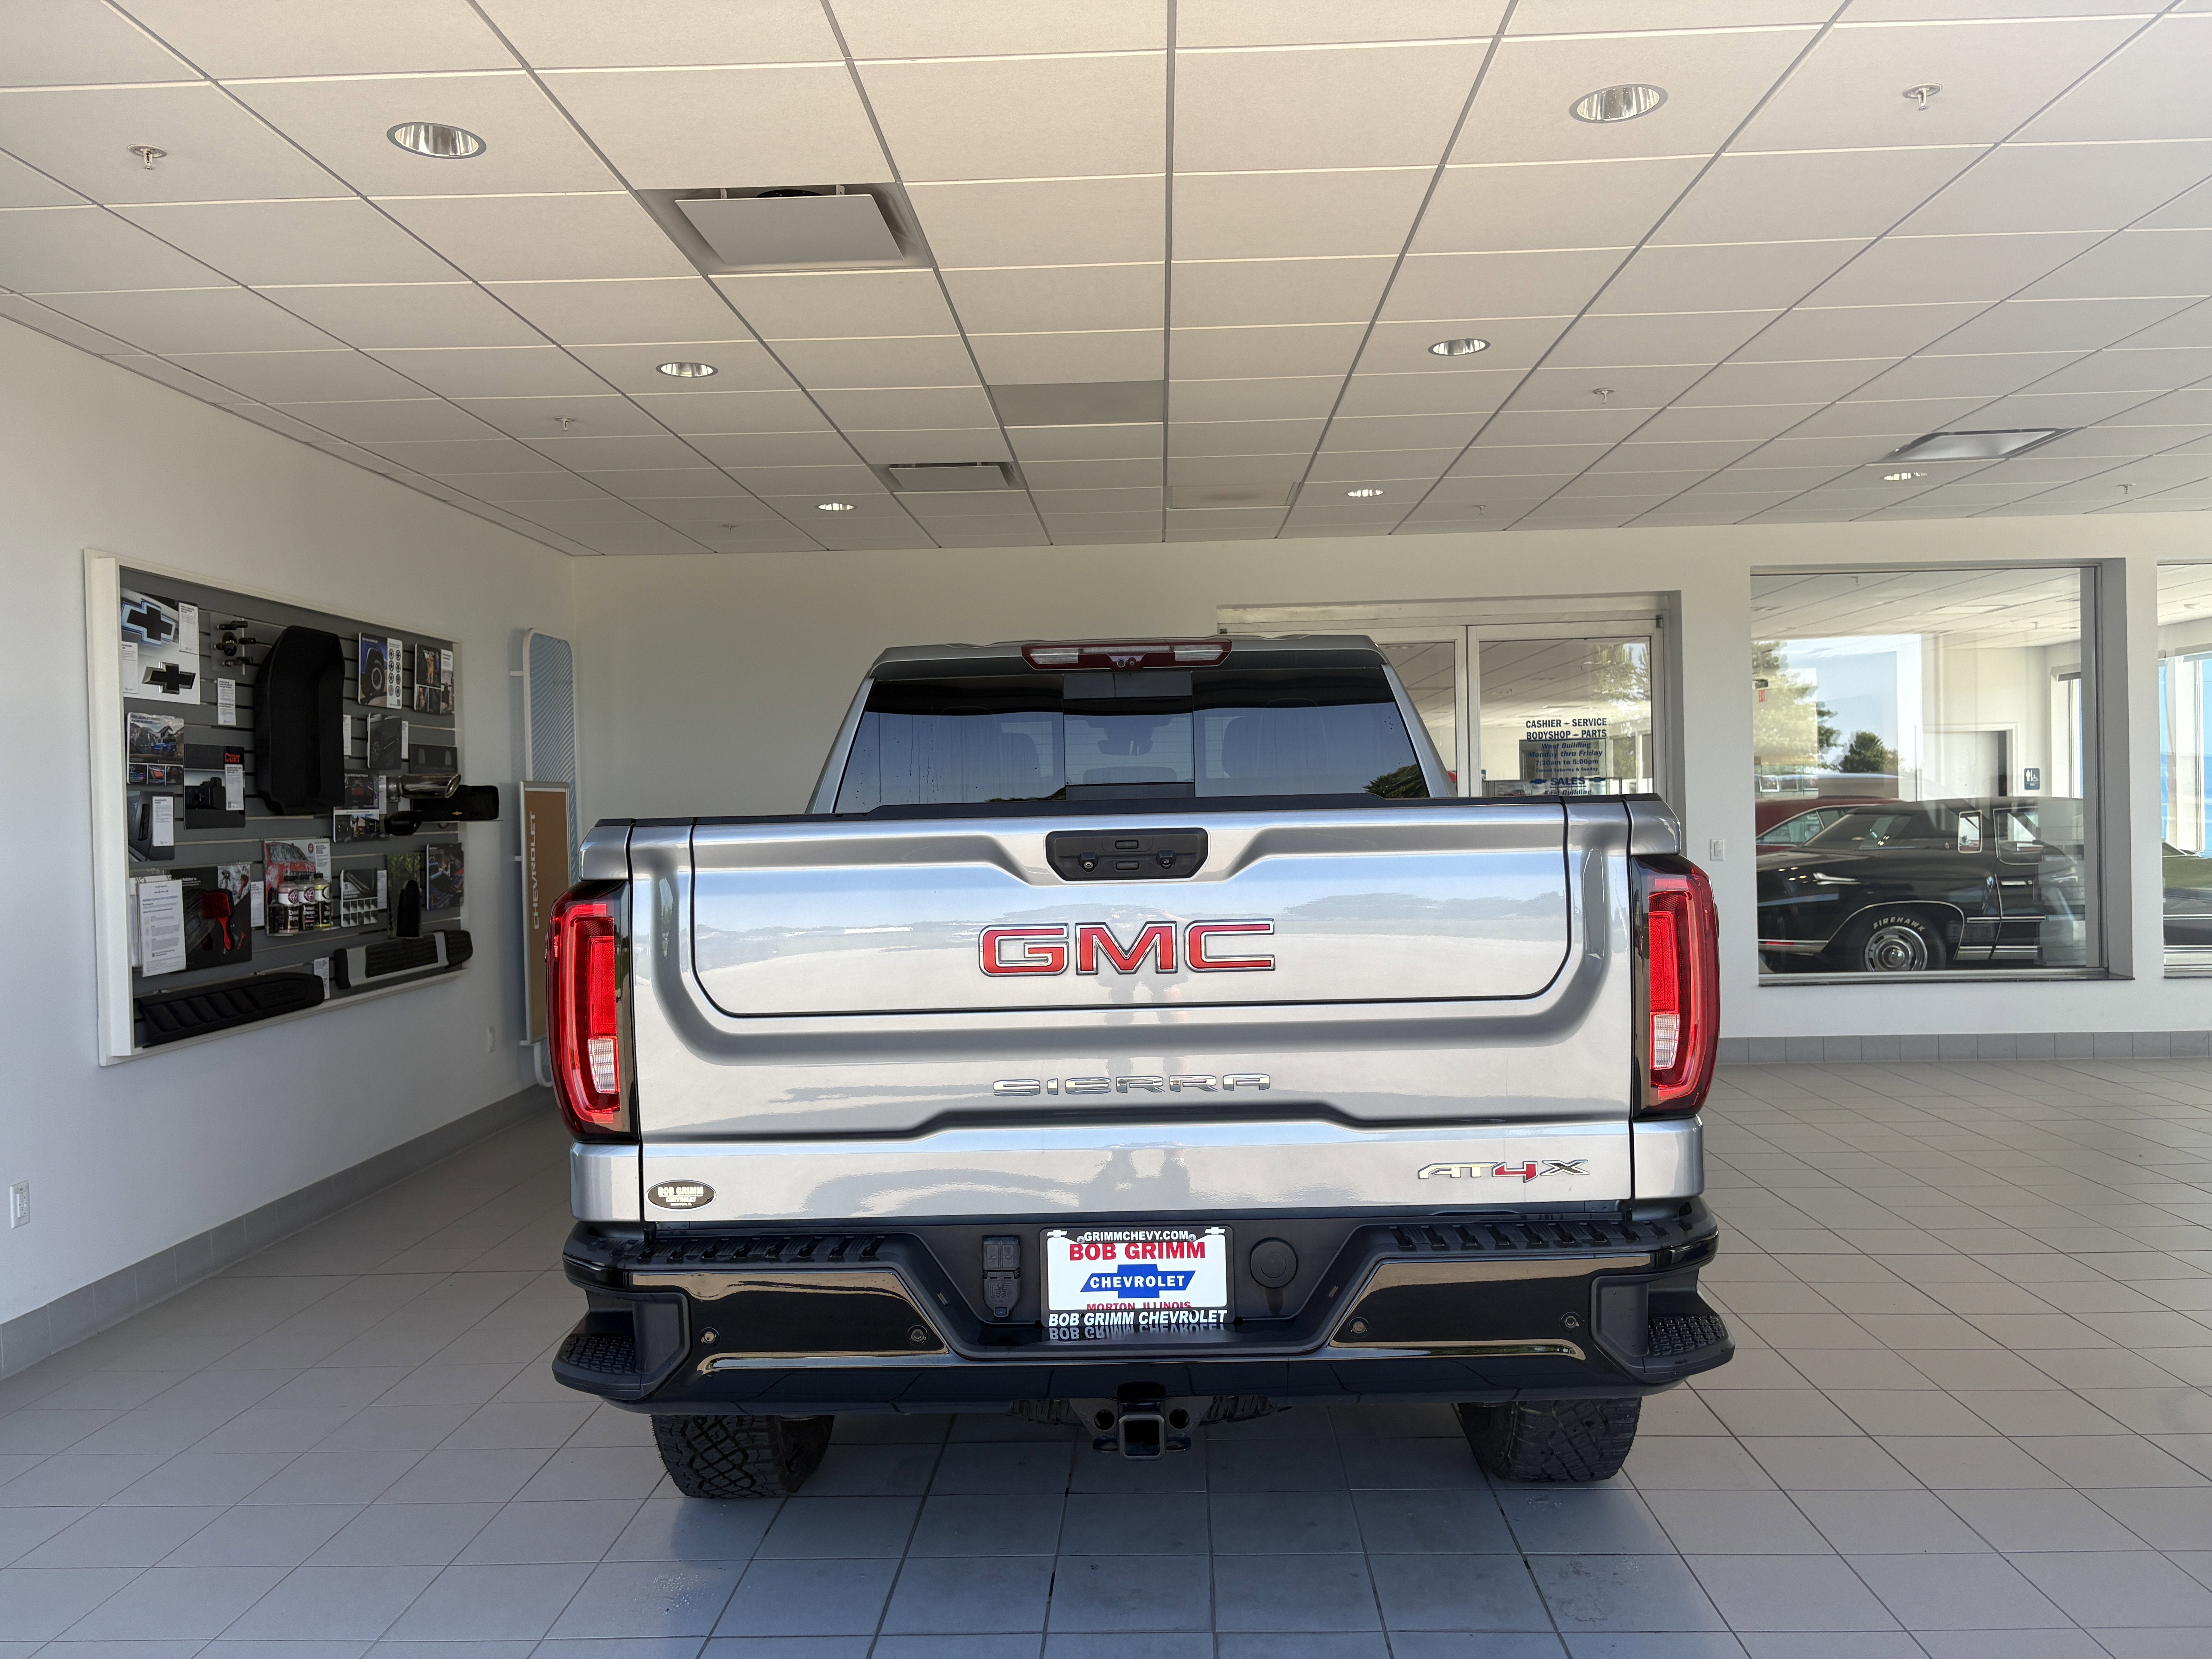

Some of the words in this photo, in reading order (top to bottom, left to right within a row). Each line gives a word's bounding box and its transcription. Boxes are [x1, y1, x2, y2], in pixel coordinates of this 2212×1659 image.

[1526, 719, 1561, 728] CASHIER
[1572, 718, 1607, 726] SERVICE
[1527, 730, 1571, 740] BODYSHOP
[1582, 729, 1607, 738] PARTS
[1551, 777, 1585, 785] SALES
[530, 811, 539, 929] CHEVROLET
[1873, 917, 1925, 932] FIREHAWK
[979, 918, 1276, 977] GMC
[993, 1073, 1270, 1096] SIERRA
[1417, 1159, 1590, 1183] AT4X
[658, 1187, 675, 1195] BOB
[676, 1186, 704, 1195] GRIMM
[1084, 1230, 1188, 1242] GRIMMCHEVY.COM
[1070, 1243, 1116, 1261] BOB
[1125, 1242, 1206, 1260] GRIMM
[1090, 1275, 1185, 1288] CHEVROLET
[1087, 1302, 1135, 1310] MORTON
[1048, 1313, 1080, 1326] BOB
[1084, 1312, 1135, 1326] GRIMM
[1139, 1310, 1228, 1324] CHEVROLET
